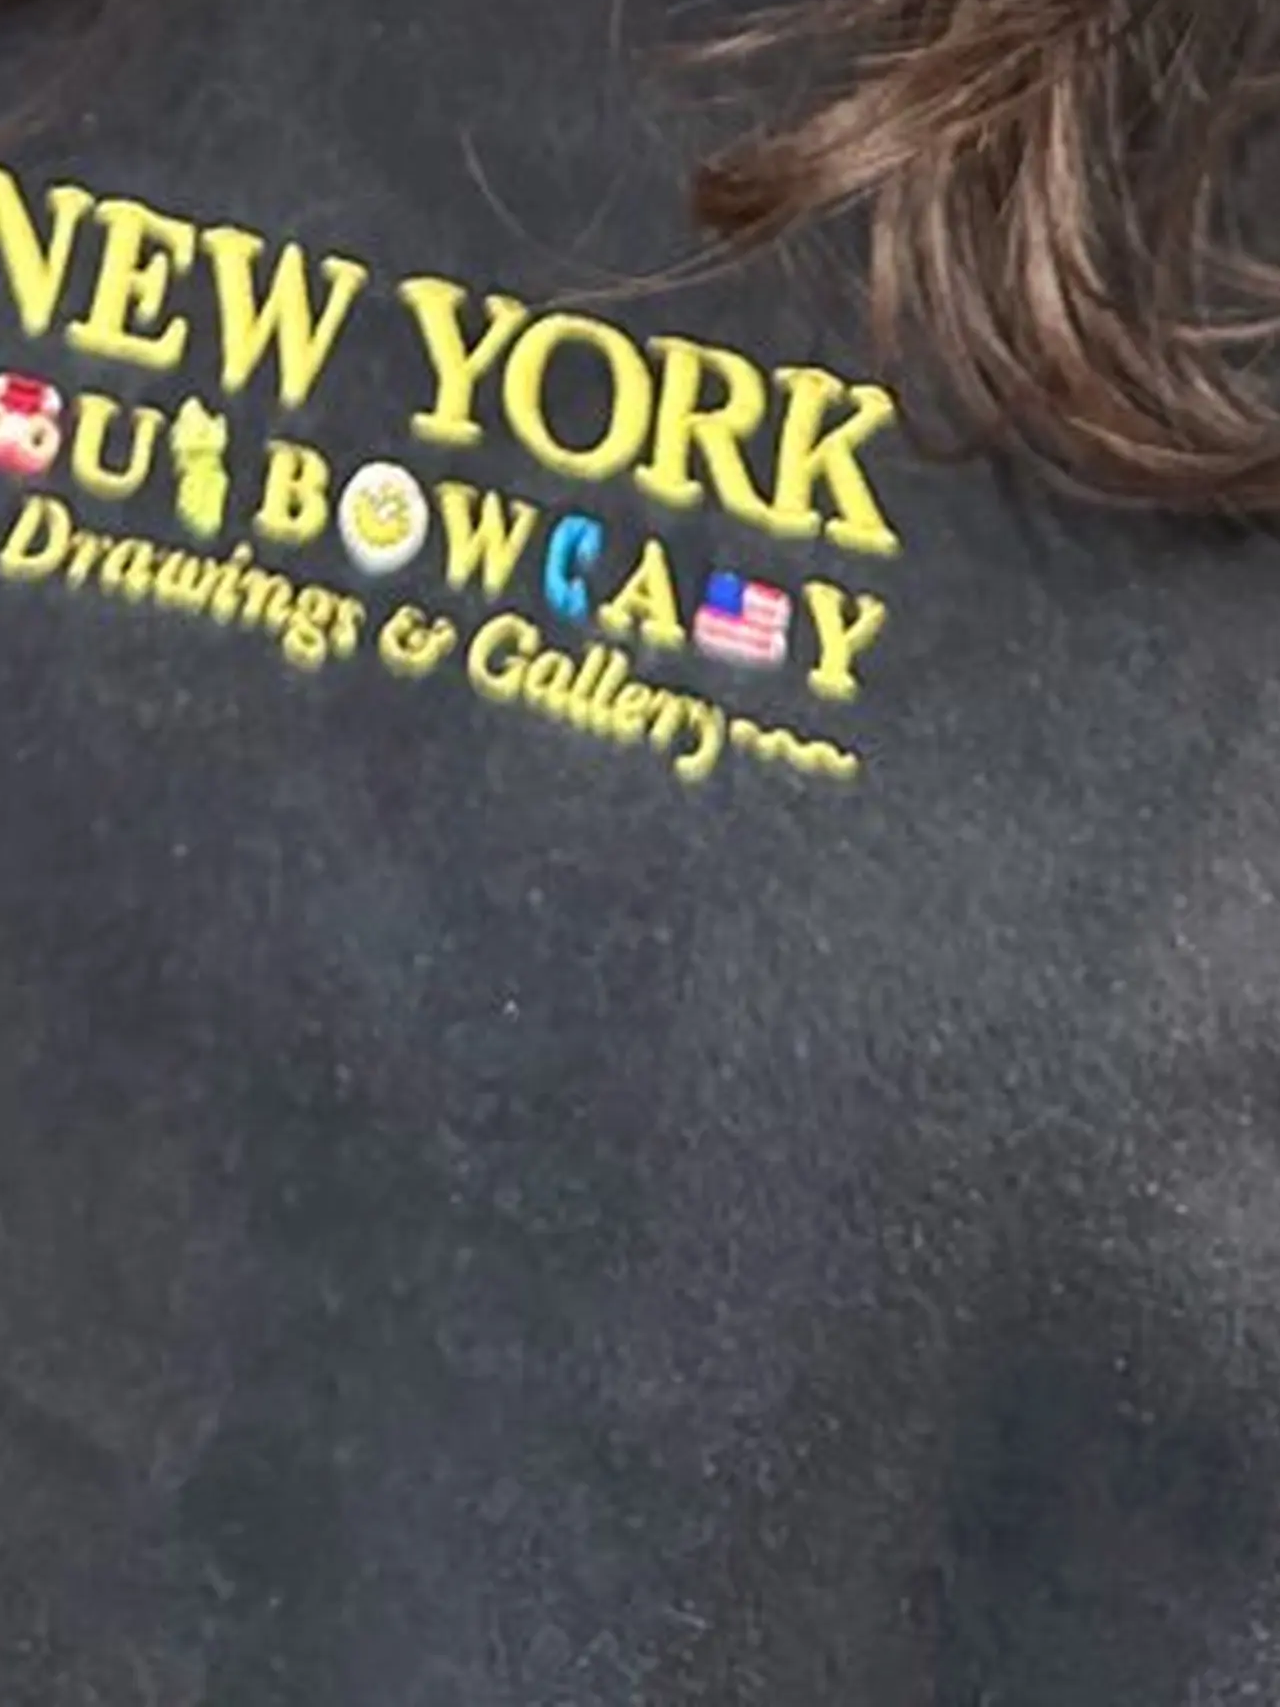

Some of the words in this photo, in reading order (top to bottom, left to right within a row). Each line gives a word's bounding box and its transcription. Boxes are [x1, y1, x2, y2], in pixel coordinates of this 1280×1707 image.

[396, 275, 904, 557] YORK
[378, 602, 457, 678] &
[467, 611, 724, 783] Gallery
